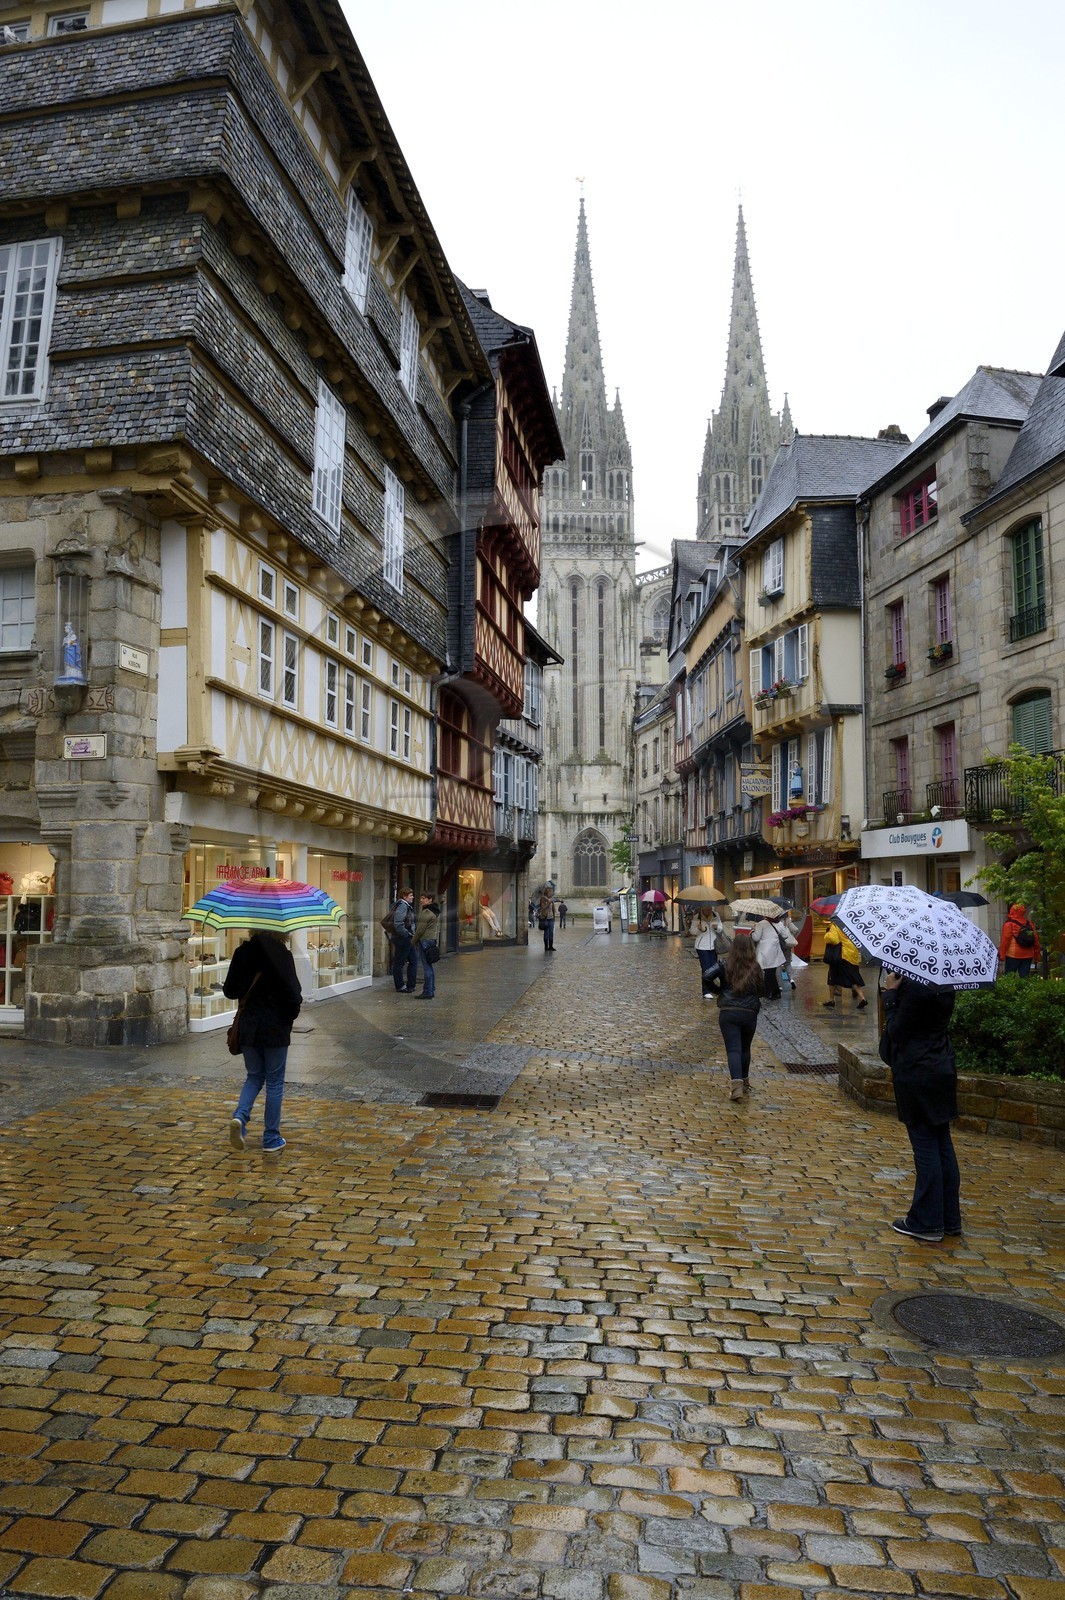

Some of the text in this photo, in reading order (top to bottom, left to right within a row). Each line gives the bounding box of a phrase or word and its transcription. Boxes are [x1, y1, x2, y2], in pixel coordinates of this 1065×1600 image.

[889, 833, 927, 845] Club Bouygues
[217, 865, 267, 880] FRANCE ARN
[882, 961, 930, 986] BRETAGNE
